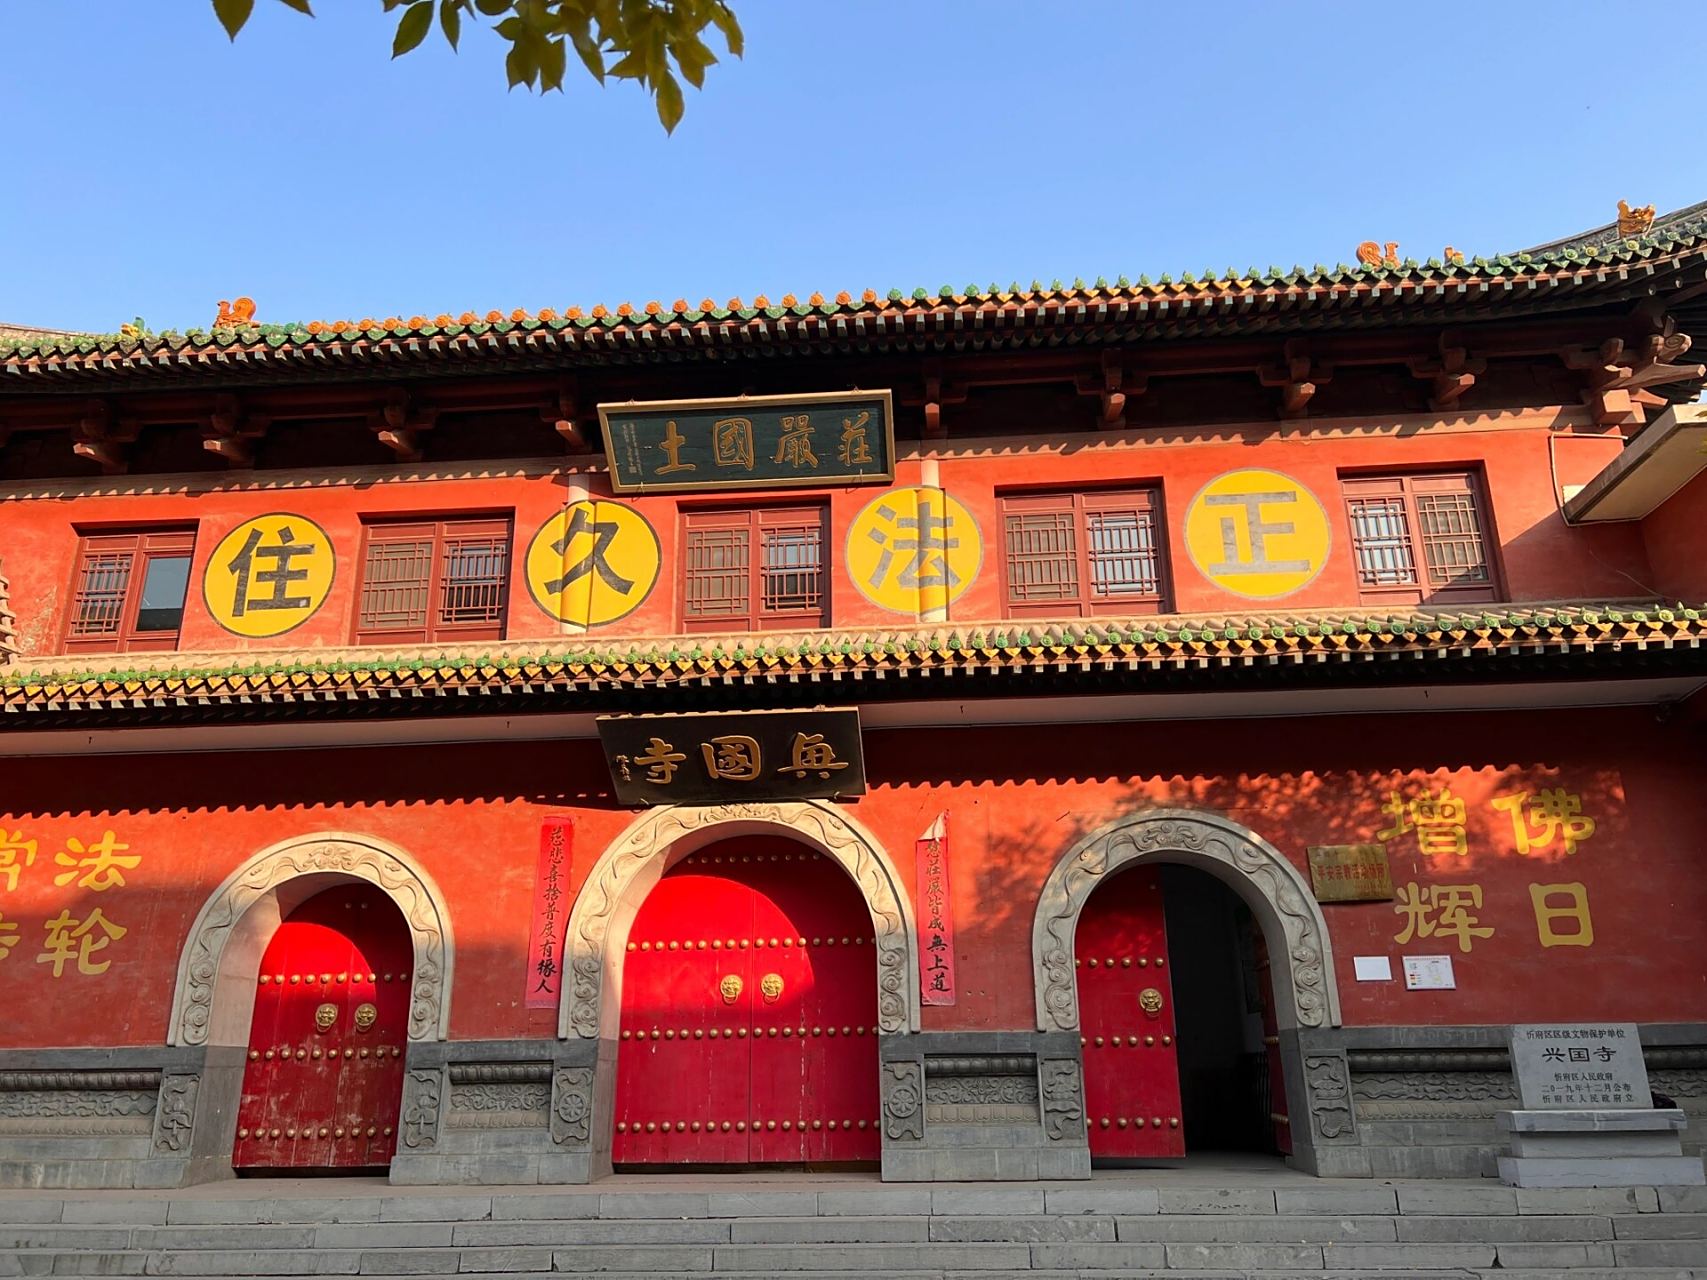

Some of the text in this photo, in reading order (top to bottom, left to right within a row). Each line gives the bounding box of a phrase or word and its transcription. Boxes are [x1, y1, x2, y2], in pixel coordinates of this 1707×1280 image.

[227, 491, 1311, 618] 正 法 久 住
[1526, 1028, 1626, 1040] 忻府区区级文物保护单位
[1541, 1046, 1617, 1063] 兴国寺
[1554, 1072, 1613, 1082] 忻府区人民政府
